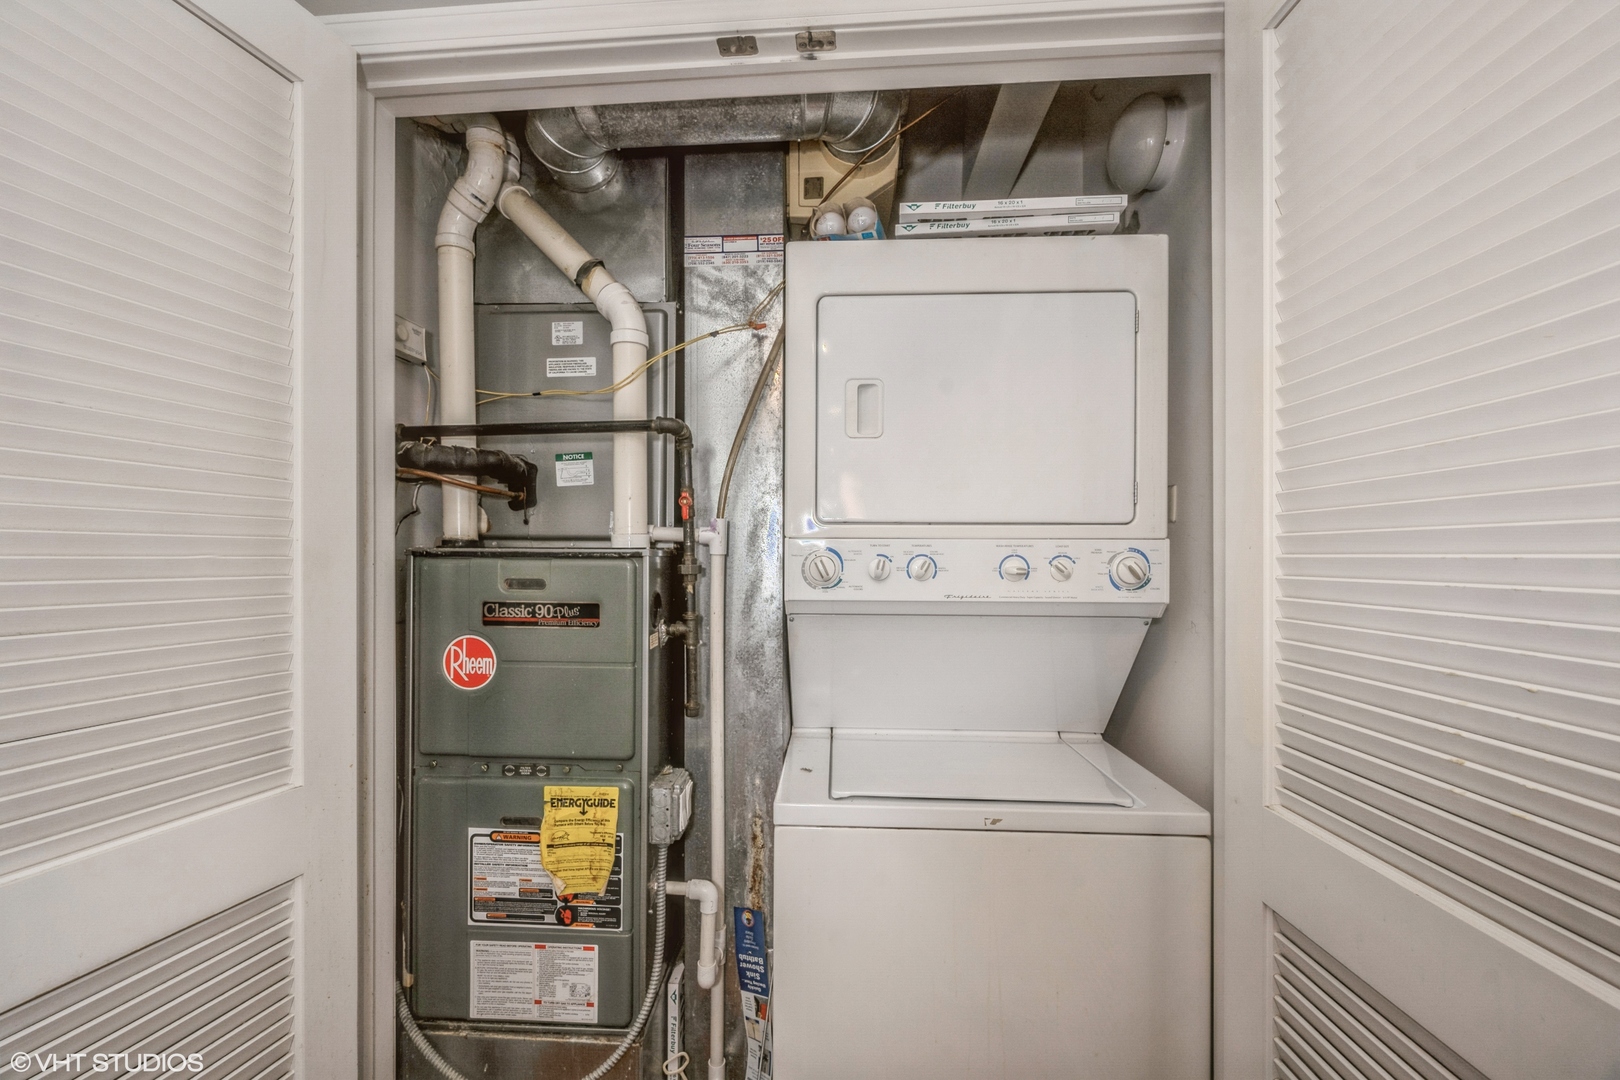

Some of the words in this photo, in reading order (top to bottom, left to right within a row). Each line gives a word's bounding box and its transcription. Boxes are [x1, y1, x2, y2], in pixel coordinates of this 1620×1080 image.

[942, 202, 976, 210] Filterbuy
[484, 603, 533, 618] Classic
[567, 619, 599, 627] Efficiency
[450, 638, 493, 681] Rheem
[550, 797, 616, 809] ENERGYGUIDE
[738, 953, 764, 965] Bathtub
[739, 962, 765, 973] Shower
[745, 970, 761, 980] Sink
